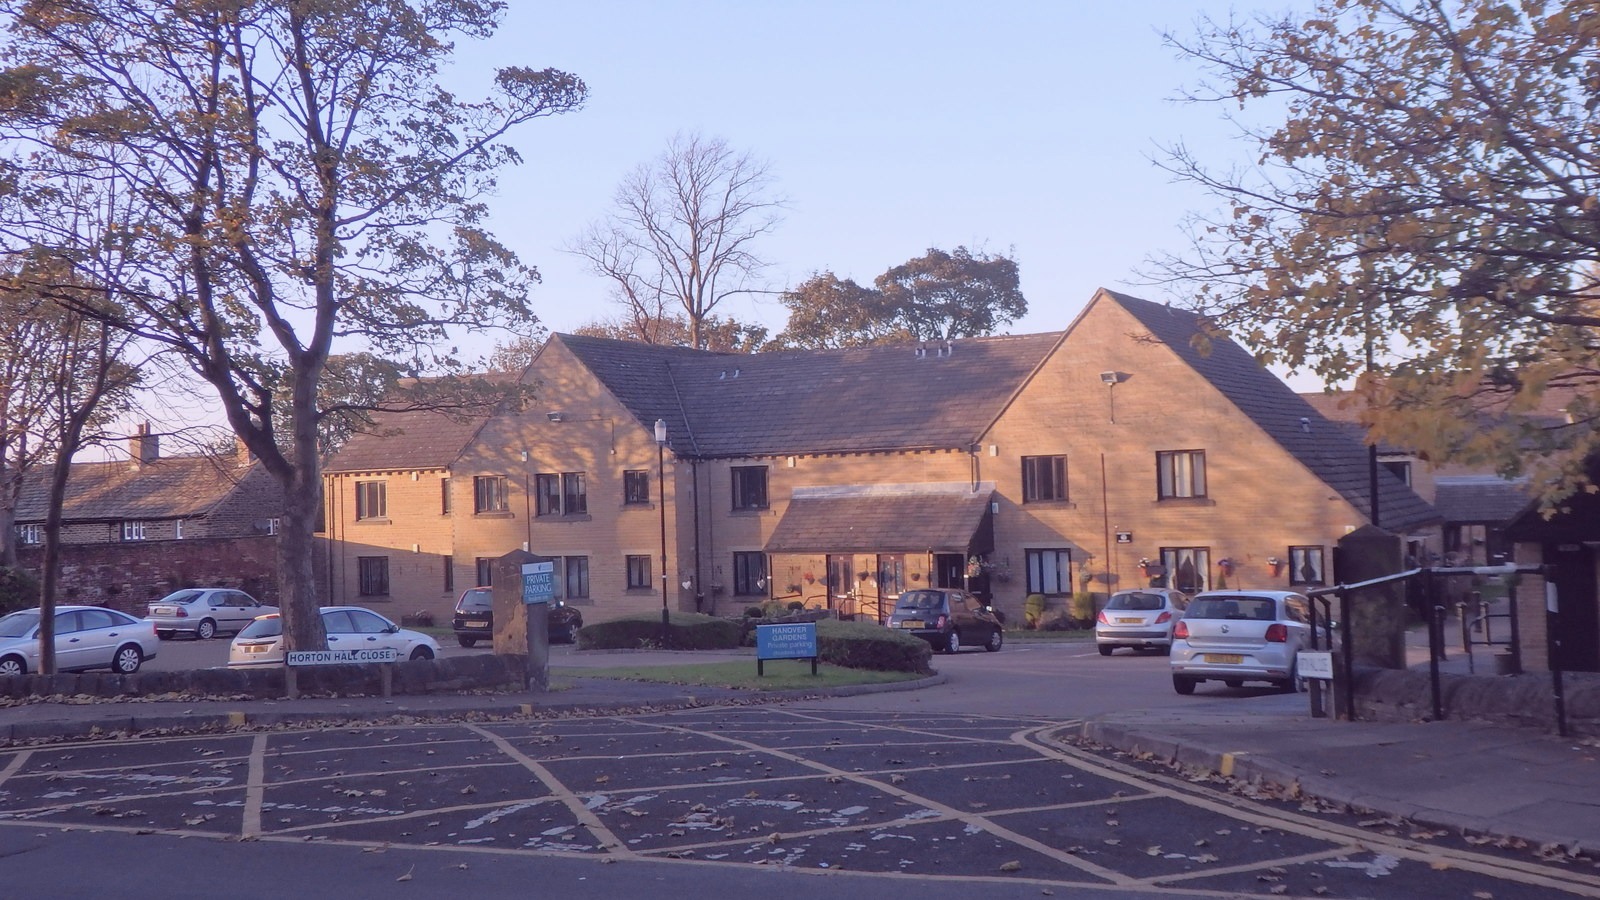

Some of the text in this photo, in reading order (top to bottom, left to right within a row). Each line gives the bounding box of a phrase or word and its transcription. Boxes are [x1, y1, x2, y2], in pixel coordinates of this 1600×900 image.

[526, 574, 550, 584] PRIVATE
[525, 583, 552, 594] PARKING
[290, 653, 331, 662] HORTON
[334, 652, 358, 661] HALL
[360, 651, 390, 660] CLOSE
